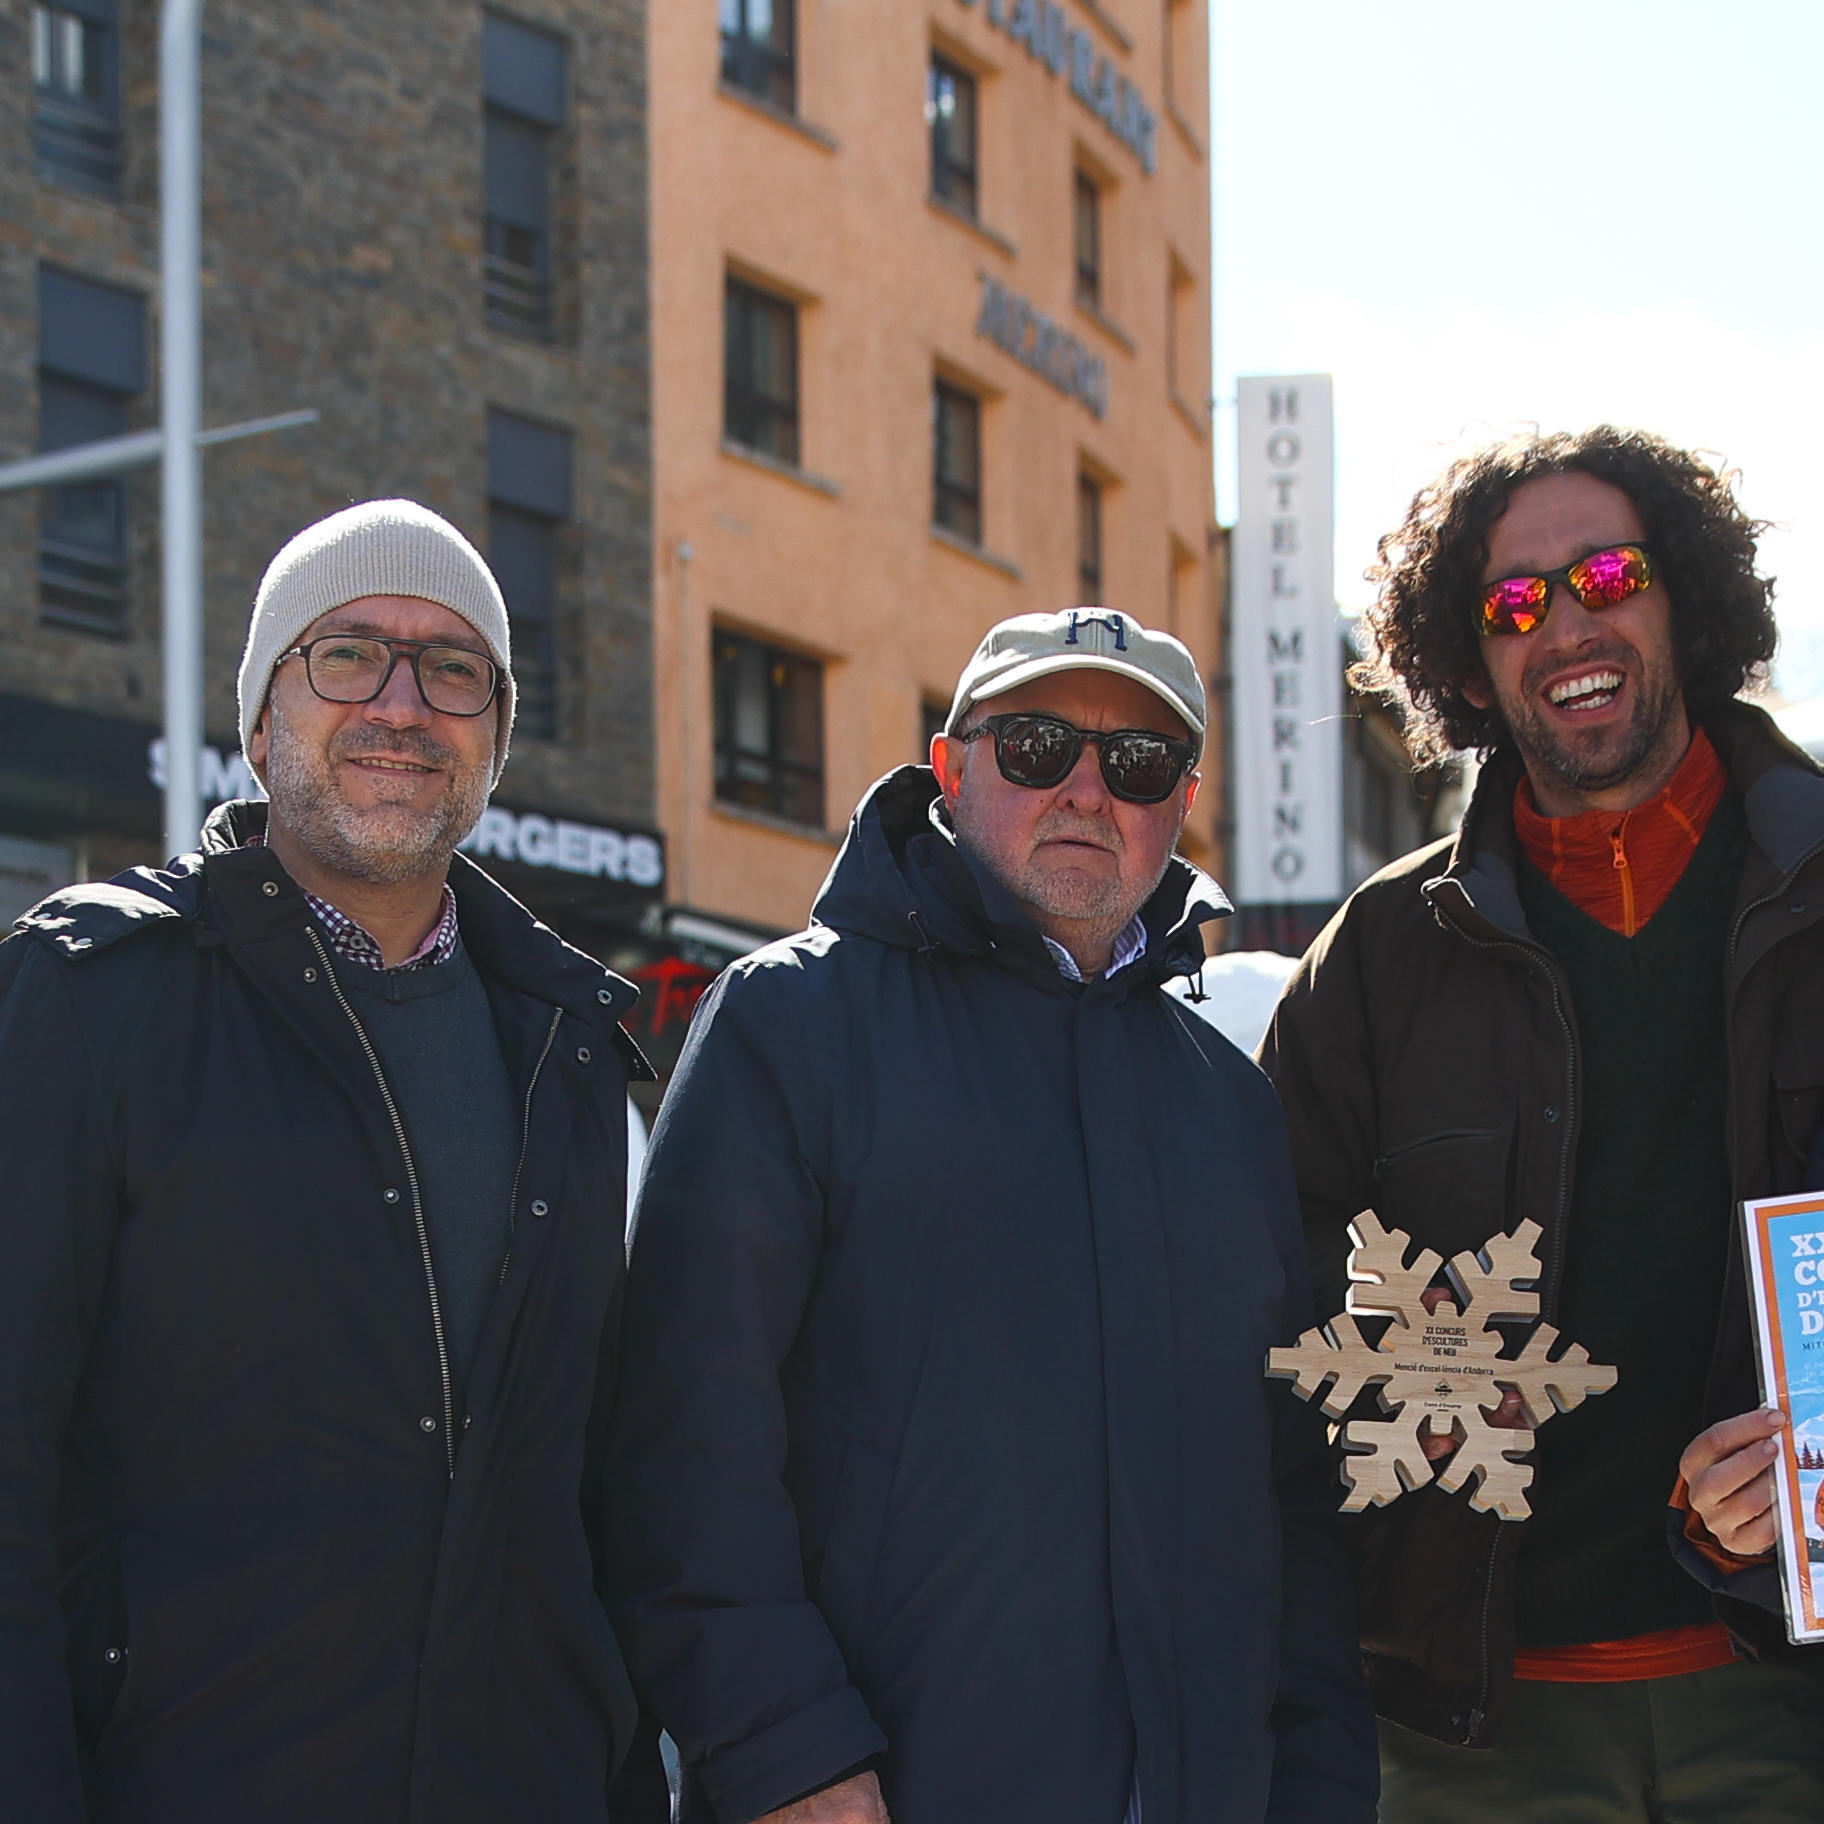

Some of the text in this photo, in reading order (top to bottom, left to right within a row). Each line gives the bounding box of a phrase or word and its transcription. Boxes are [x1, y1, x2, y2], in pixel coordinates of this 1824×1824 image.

[1266, 390, 1304, 883] HOTEL MERINO
[455, 803, 664, 888] RGERS
[1425, 1326, 1466, 1336] XX CONCURS
[1422, 1336, 1468, 1347] D'ESCULTURES
[1433, 1347, 1457, 1357] DE NEU
[1395, 1363, 1417, 1372] Menció
[1463, 1366, 1494, 1375] d'Andorra
